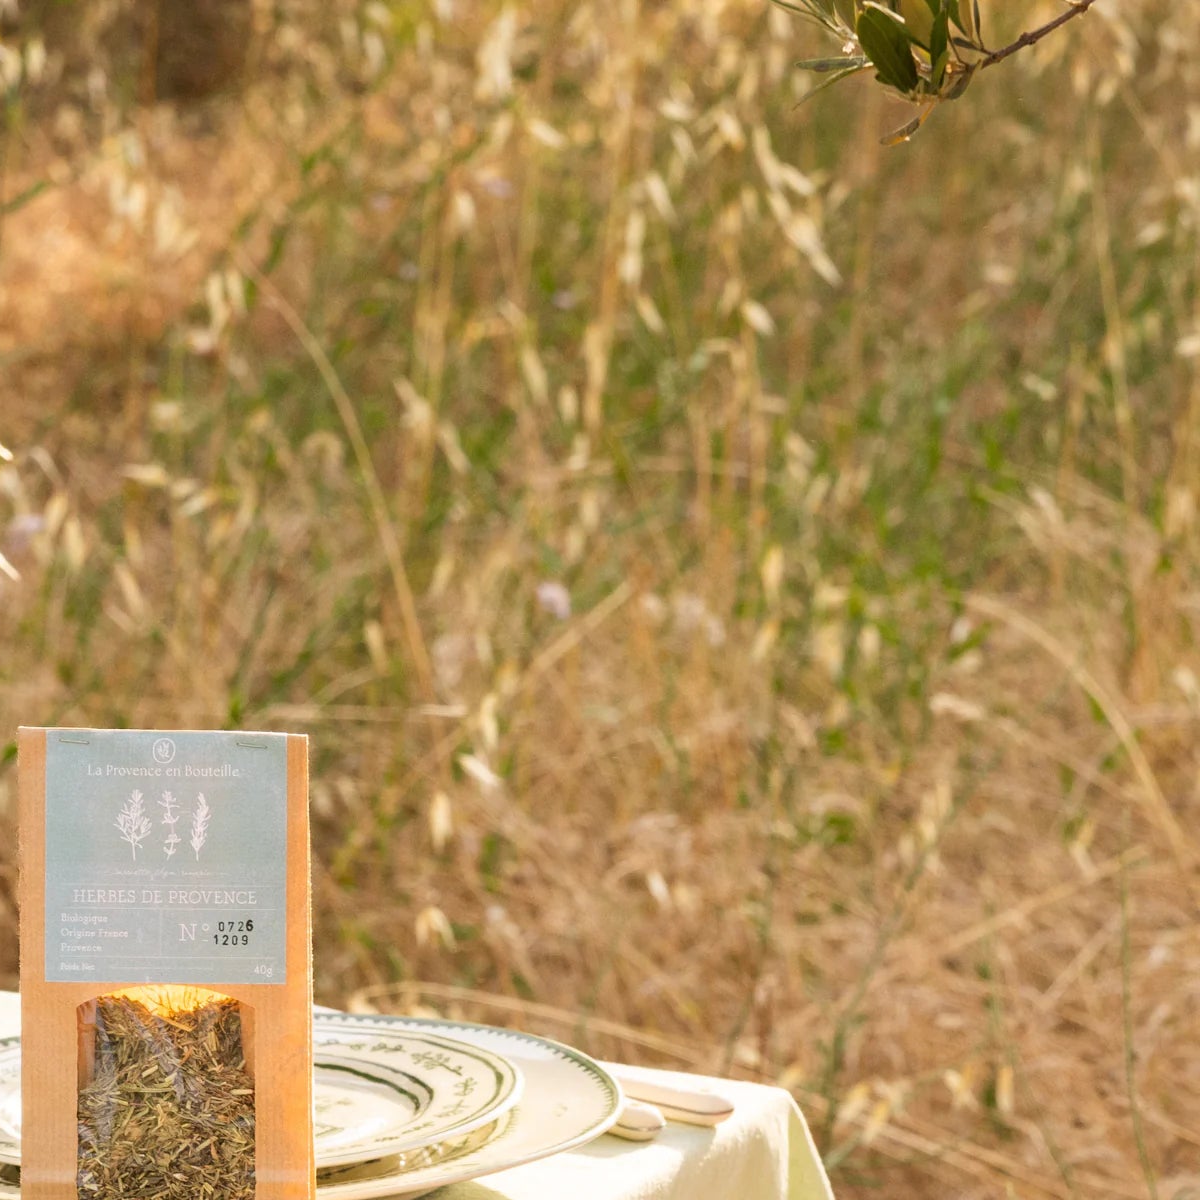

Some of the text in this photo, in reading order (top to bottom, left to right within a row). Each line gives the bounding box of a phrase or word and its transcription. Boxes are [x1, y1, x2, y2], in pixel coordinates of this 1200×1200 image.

[87, 764, 240, 777] La Provence en Bouteille
[73, 889, 257, 905] HERBES DE PROVENCE
[60, 912, 108, 925] Biologique
[218, 919, 254, 932] 0726
[60, 927, 129, 939] Origine France
[213, 934, 249, 946] 1209
[60, 942, 102, 952] Provence
[254, 964, 273, 978] 40g
